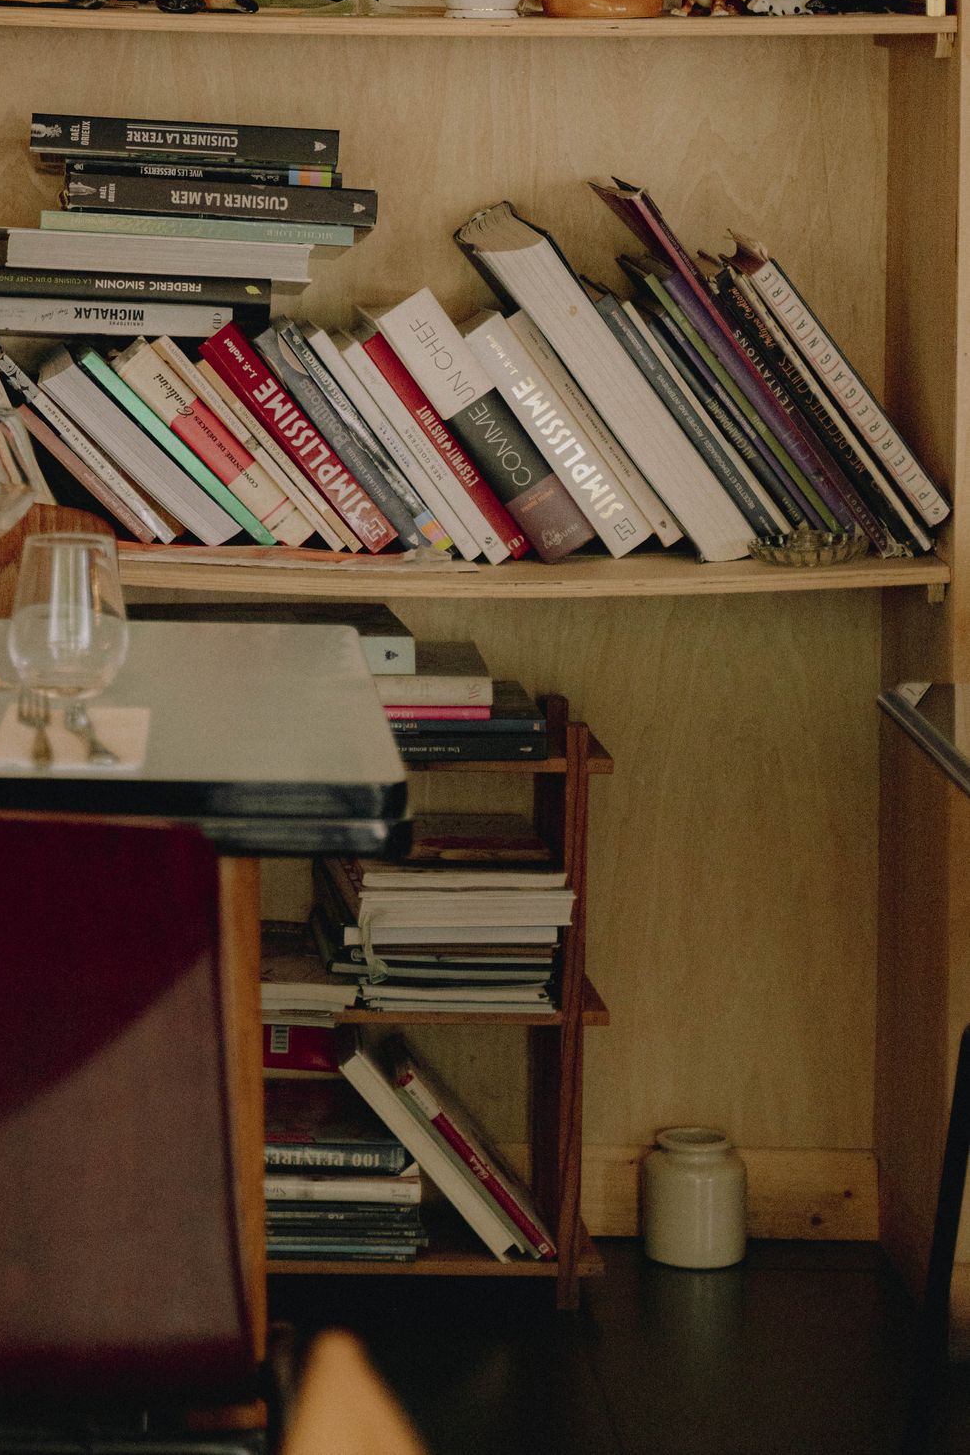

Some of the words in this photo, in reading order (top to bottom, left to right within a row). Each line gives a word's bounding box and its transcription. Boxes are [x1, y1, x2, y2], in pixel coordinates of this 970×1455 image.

[80, 120, 90, 145] ORIEUX
[126, 130, 164, 143] TERRE
[165, 132, 180, 144] LA
[182, 132, 238, 148] CUISINER
[176, 167, 188, 177] LES
[189, 168, 203, 177] VIVE
[169, 189, 201, 205] MER
[203, 191, 221, 206] LA
[223, 192, 288, 211] CUISINER
[15, 274, 33, 283] CHEF
[34, 274, 52, 283] D'UN
[53, 275, 81, 285] CUISINE
[82, 277, 92, 285] LA
[94, 277, 145, 290] SIMONIN
[148, 280, 202, 293] FREDERIC
[73, 306, 144, 321] MICHALAK
[221, 336, 246, 363] Mallet
[407, 312, 456, 374] CHEF
[729, 327, 797, 415] TENTATIONS
[776, 354, 810, 395] CULTES
[149, 371, 195, 421] Conticini
[445, 368, 478, 405] UN
[42, 402, 72, 433] Bretagne
[289, 377, 353, 450] Bouillons
[677, 403, 690, 417] AND
[803, 393, 850, 450] RECETTES
[190, 414, 218, 444] DÉLICES
[414, 402, 450, 444] BISTROT
[685, 414, 705, 438] RECIPES
[214, 439, 227, 453] DE
[246, 376, 376, 522] SIMPLISSIME
[466, 398, 535, 491] COMME
[509, 371, 625, 523] SIMPLISSIME
[741, 444, 757, 461] AU
[222, 450, 259, 490] CONCENTRÉ
[428, 463, 444, 481] MES
[445, 445, 480, 487] L'ESPRIT
[843, 448, 867, 474] MES
[363, 472, 388, 502] WILLIAM
[733, 481, 756, 510] RECETTES
[351, 1153, 381, 1167] 100
